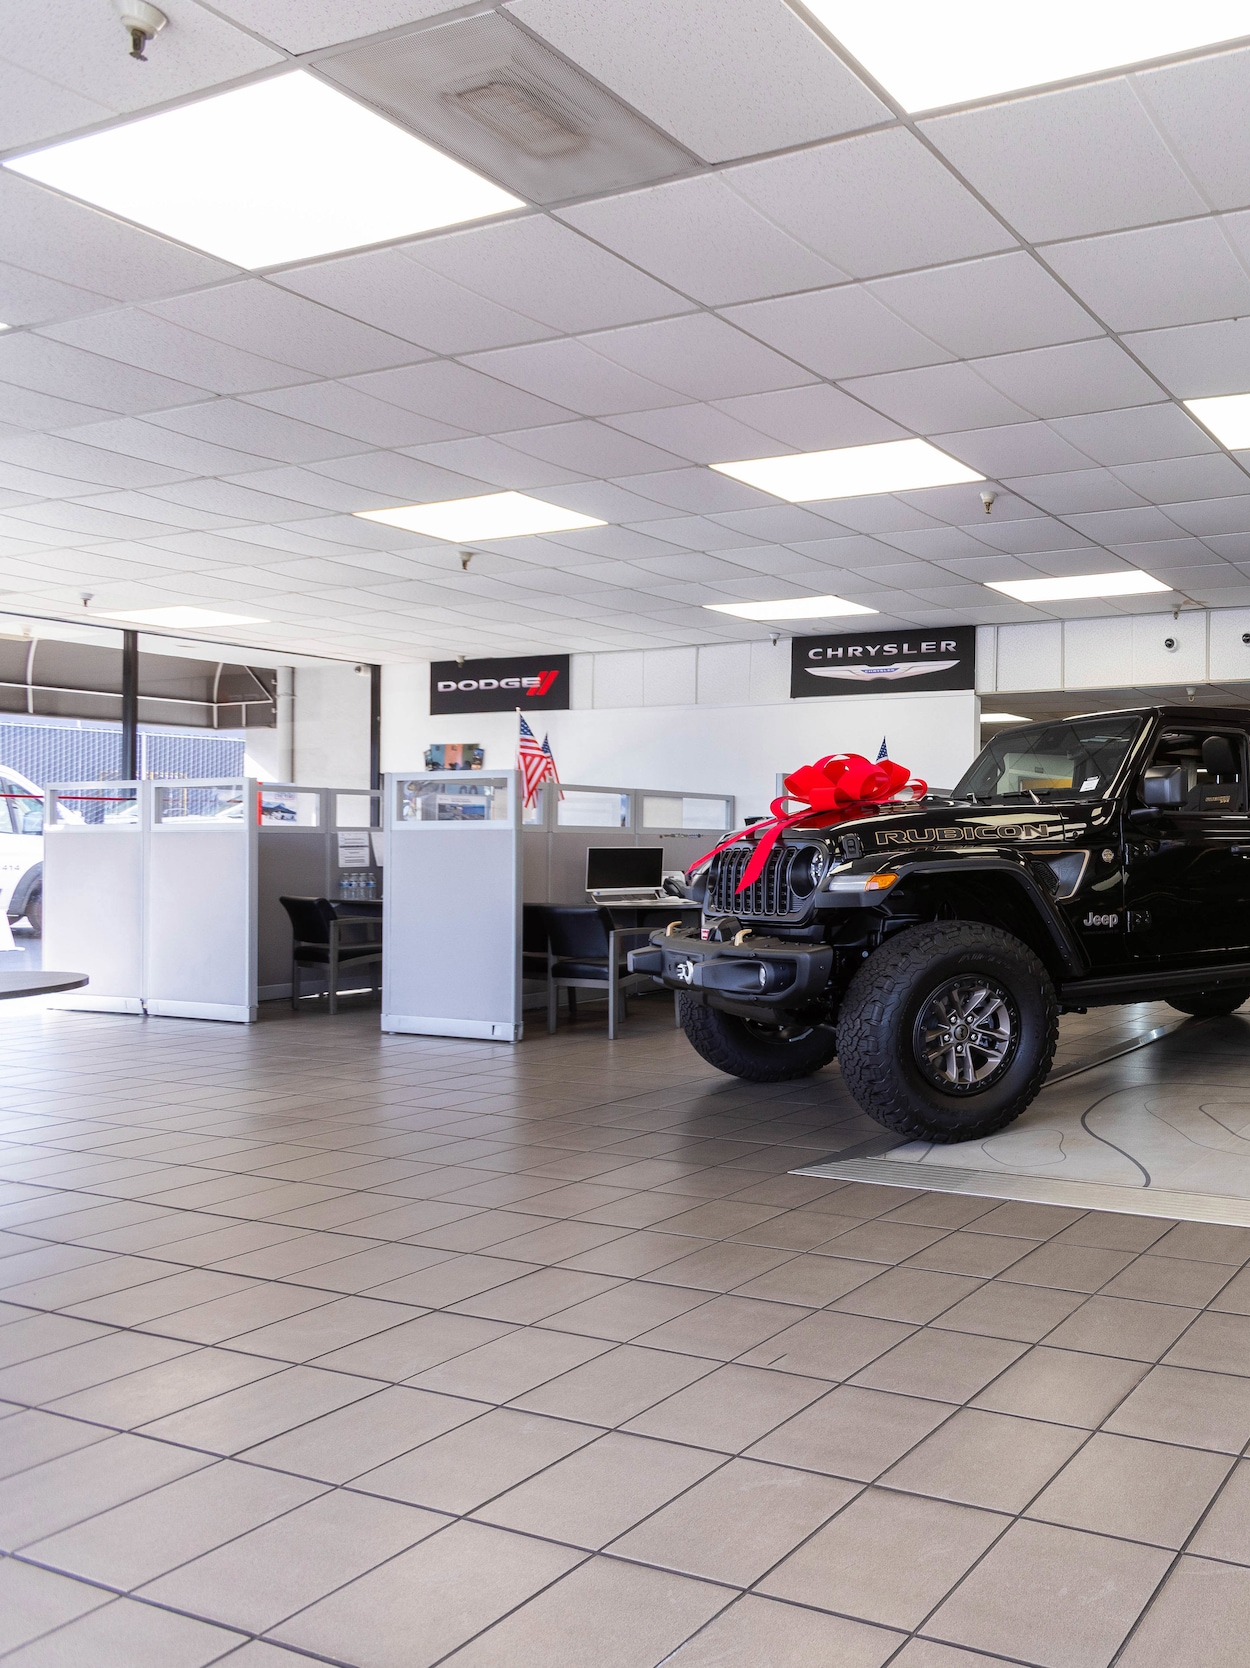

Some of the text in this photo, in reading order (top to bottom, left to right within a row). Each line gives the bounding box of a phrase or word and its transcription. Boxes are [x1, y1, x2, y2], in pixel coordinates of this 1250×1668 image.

[808, 640, 957, 660] CHRYSLER
[437, 677, 541, 692] DODGE
[875, 824, 1049, 845] RUBICON
[1083, 912, 1119, 928] Jeep
